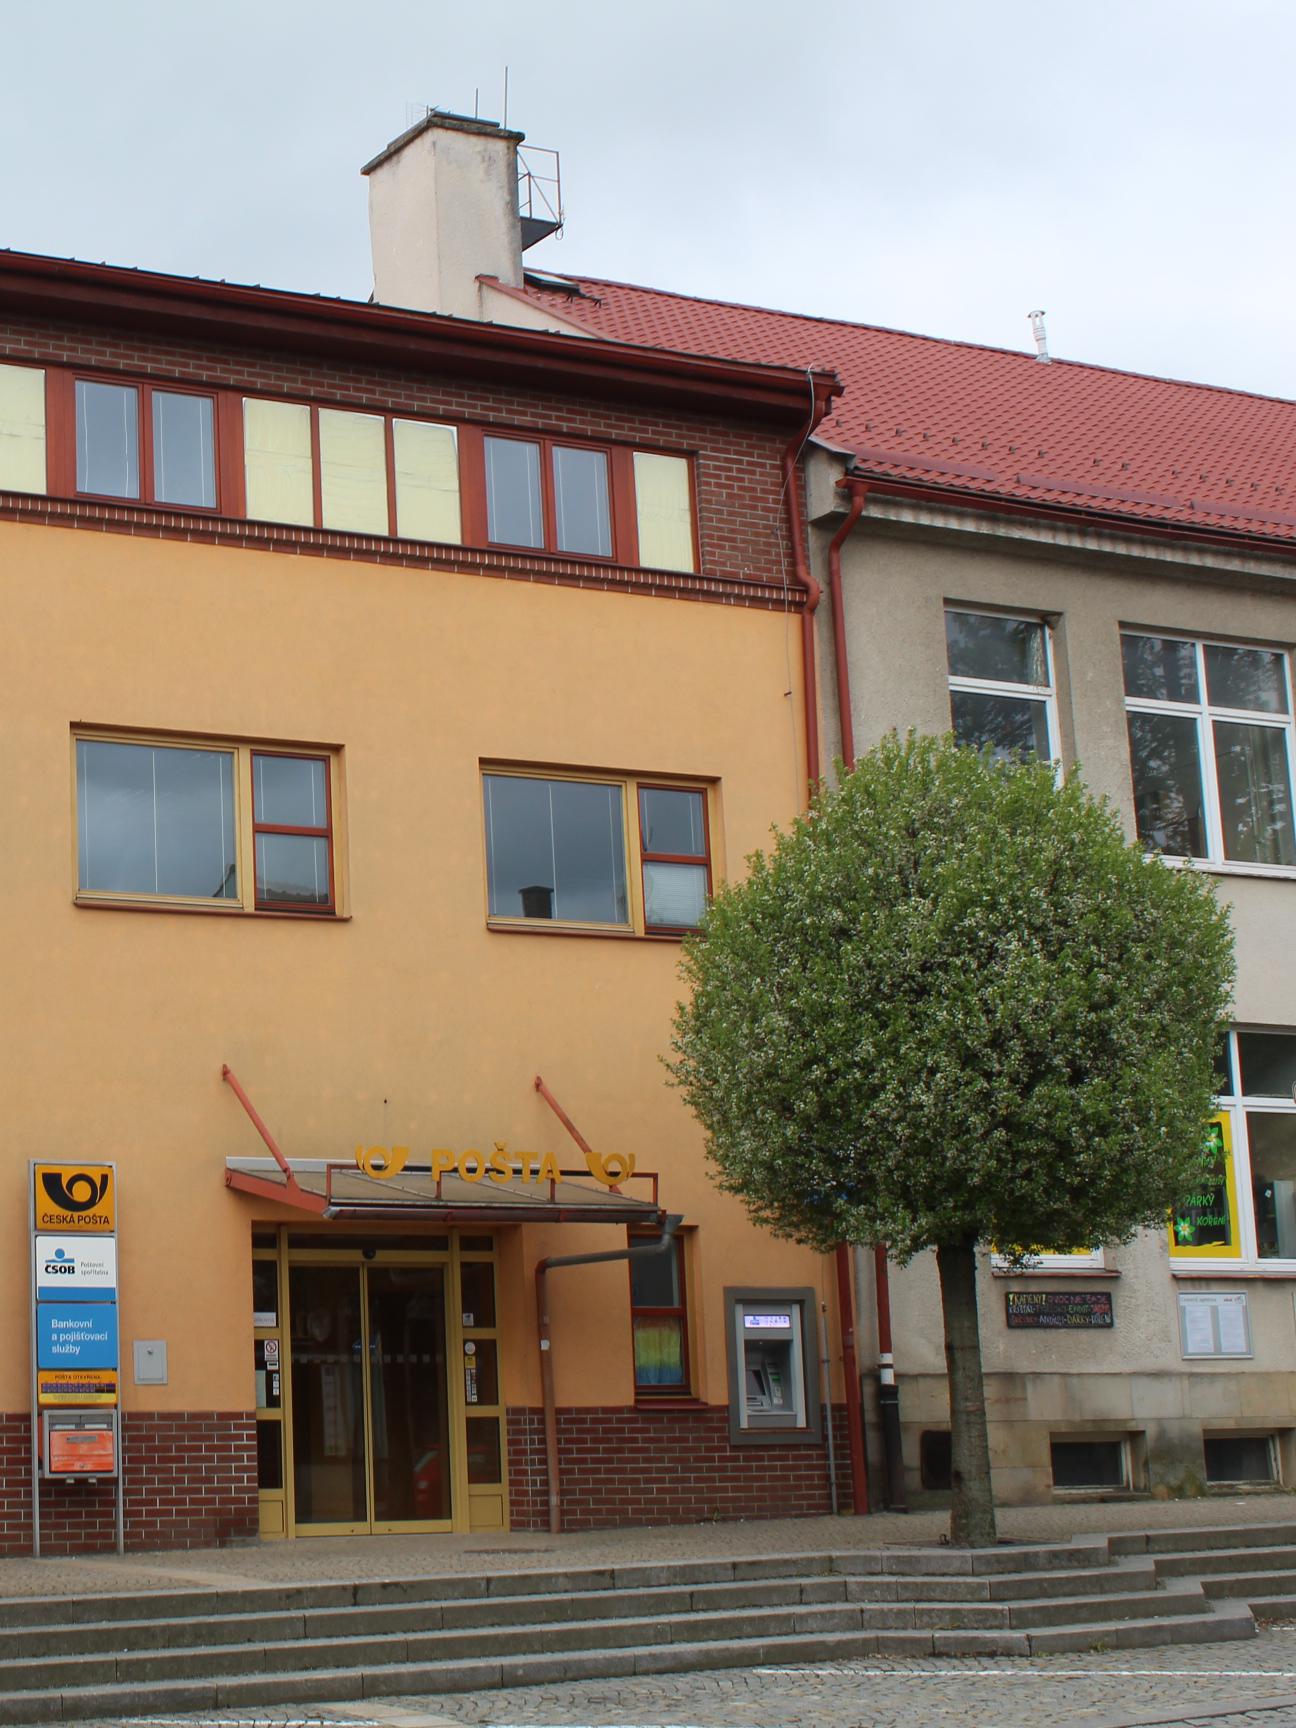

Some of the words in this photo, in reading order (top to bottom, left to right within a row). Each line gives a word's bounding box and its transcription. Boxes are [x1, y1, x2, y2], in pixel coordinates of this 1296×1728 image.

[431, 1142, 564, 1185] POŠTA
[42, 1212, 75, 1224] ČESKÁ
[77, 1212, 110, 1225] POŠTA
[44, 1263, 75, 1275] ČSOB
[51, 1318, 93, 1329] Bankovní
[51, 1332, 58, 1341] a
[59, 1330, 108, 1343] pojišťovací
[51, 1343, 81, 1356] služby
